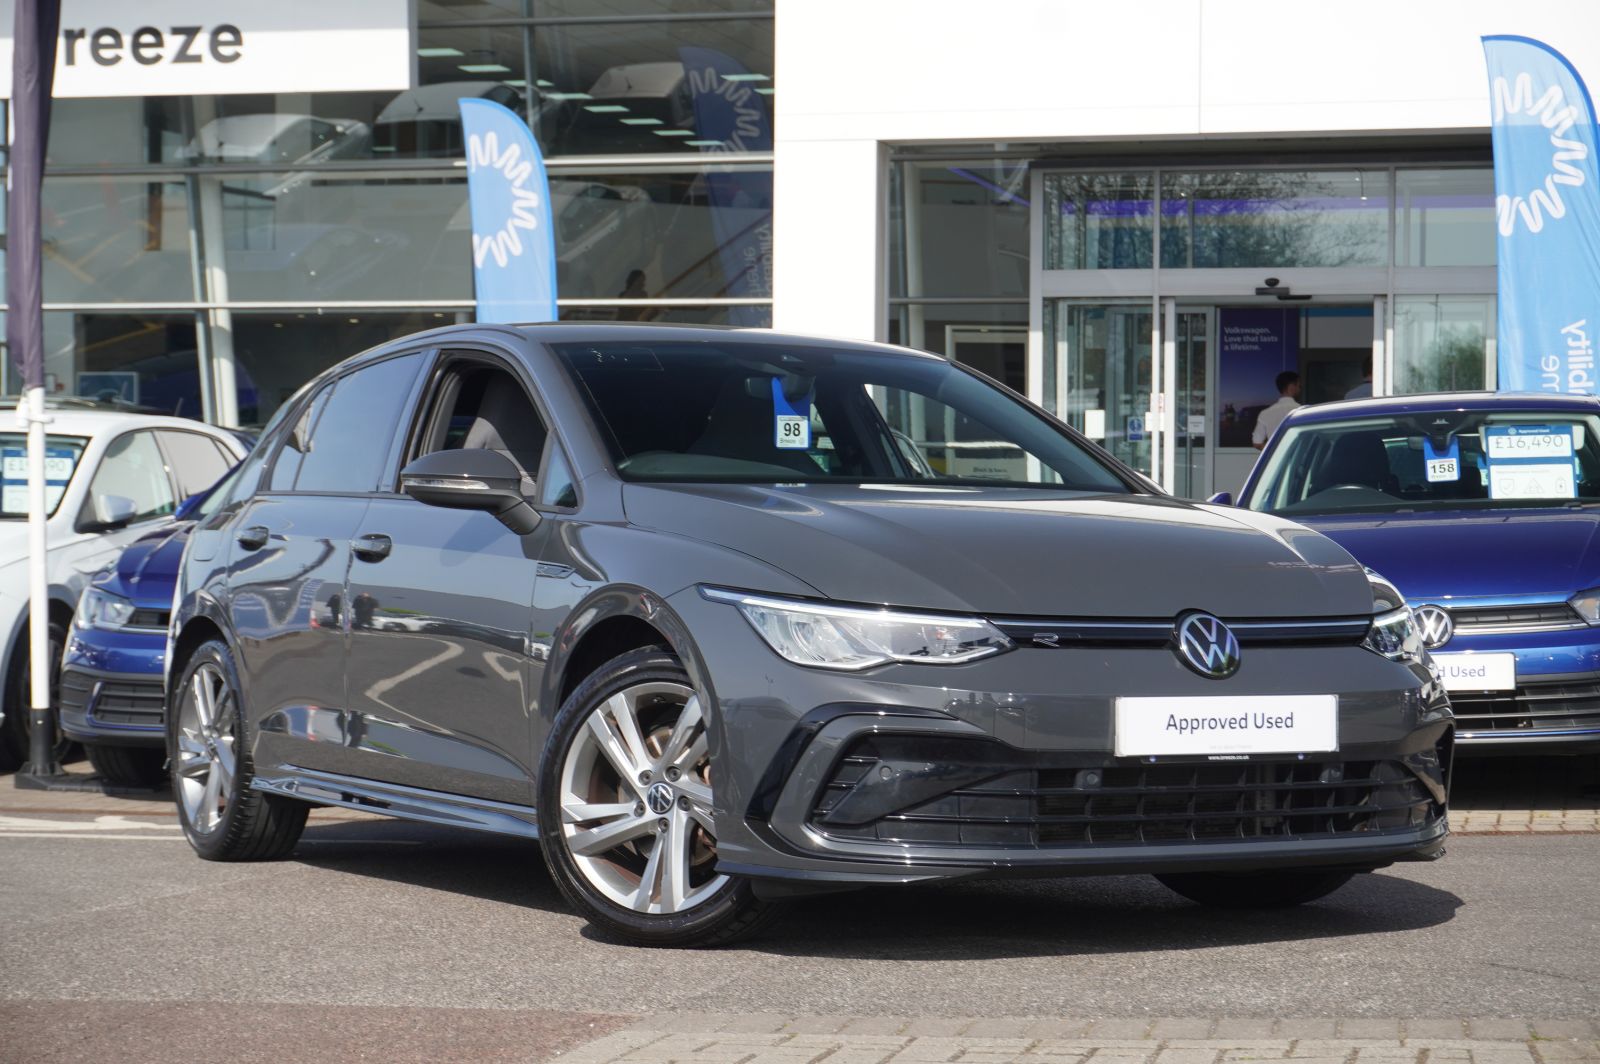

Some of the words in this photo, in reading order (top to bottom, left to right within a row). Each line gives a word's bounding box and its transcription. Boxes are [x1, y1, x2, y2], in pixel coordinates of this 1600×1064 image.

[63, 24, 244, 67] reeze
[783, 422, 801, 437] 98
[1495, 435, 1564, 449] £16,490
[1430, 463, 1455, 474] 158
[1450, 665, 1487, 678] Used
[1166, 712, 1248, 735] Approved
[1253, 711, 1294, 730] Used
